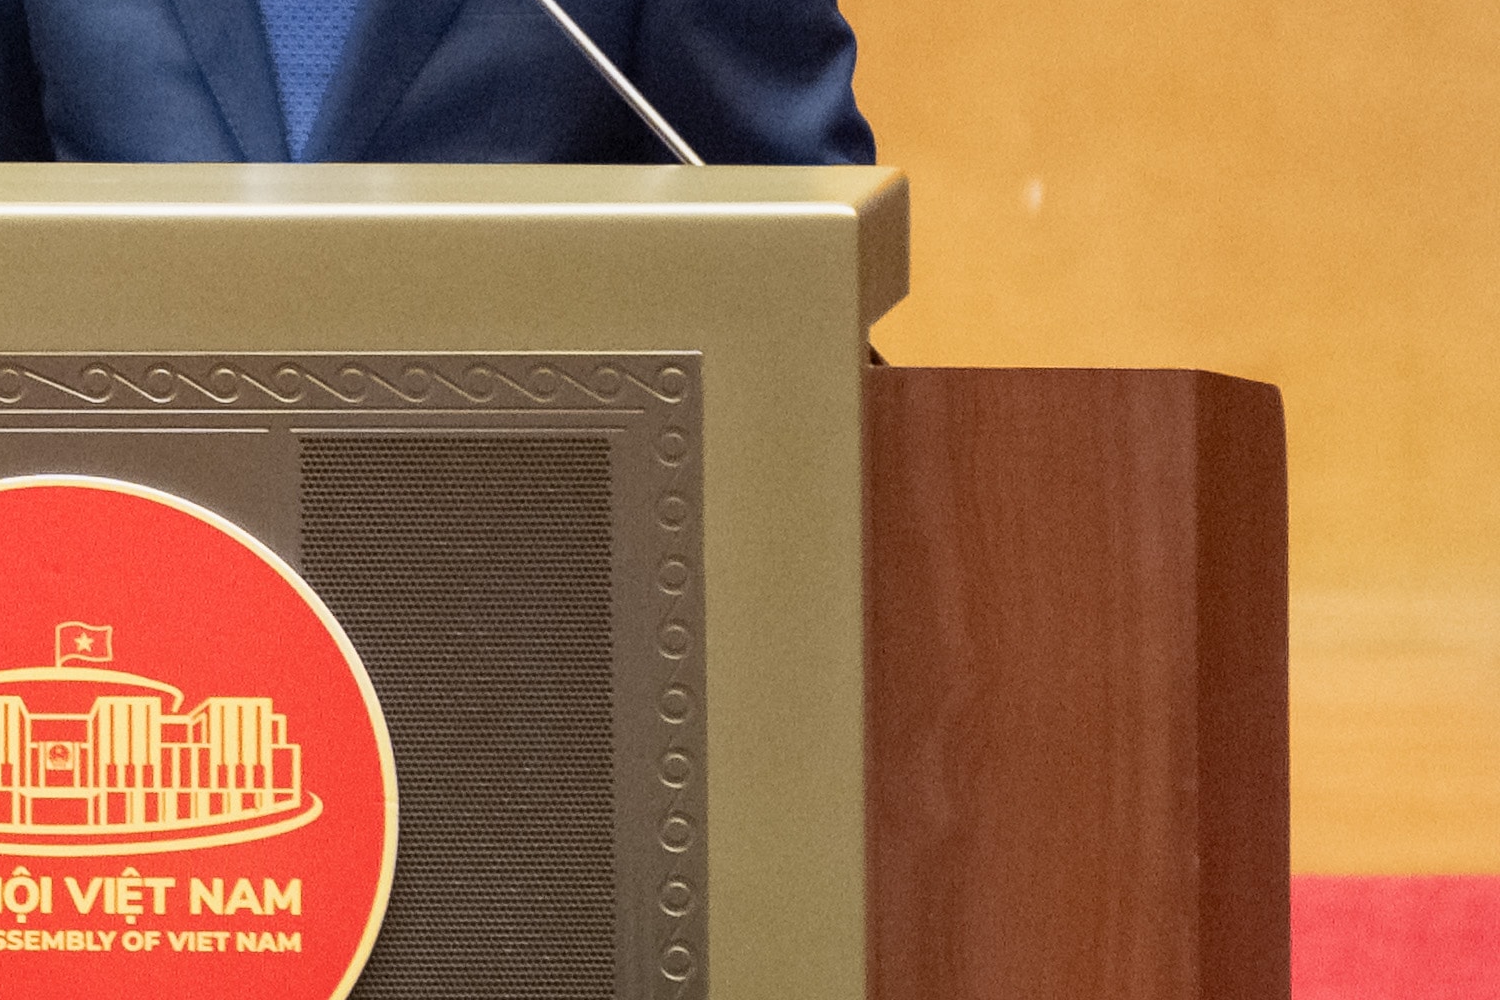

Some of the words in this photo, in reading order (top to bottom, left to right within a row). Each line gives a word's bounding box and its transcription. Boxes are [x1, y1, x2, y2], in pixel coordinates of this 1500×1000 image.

[63, 866, 176, 925] VIỆT
[189, 877, 302, 916] NAM
[121, 930, 162, 952] OF
[166, 930, 231, 952] VIET
[235, 931, 302, 953] NAM
